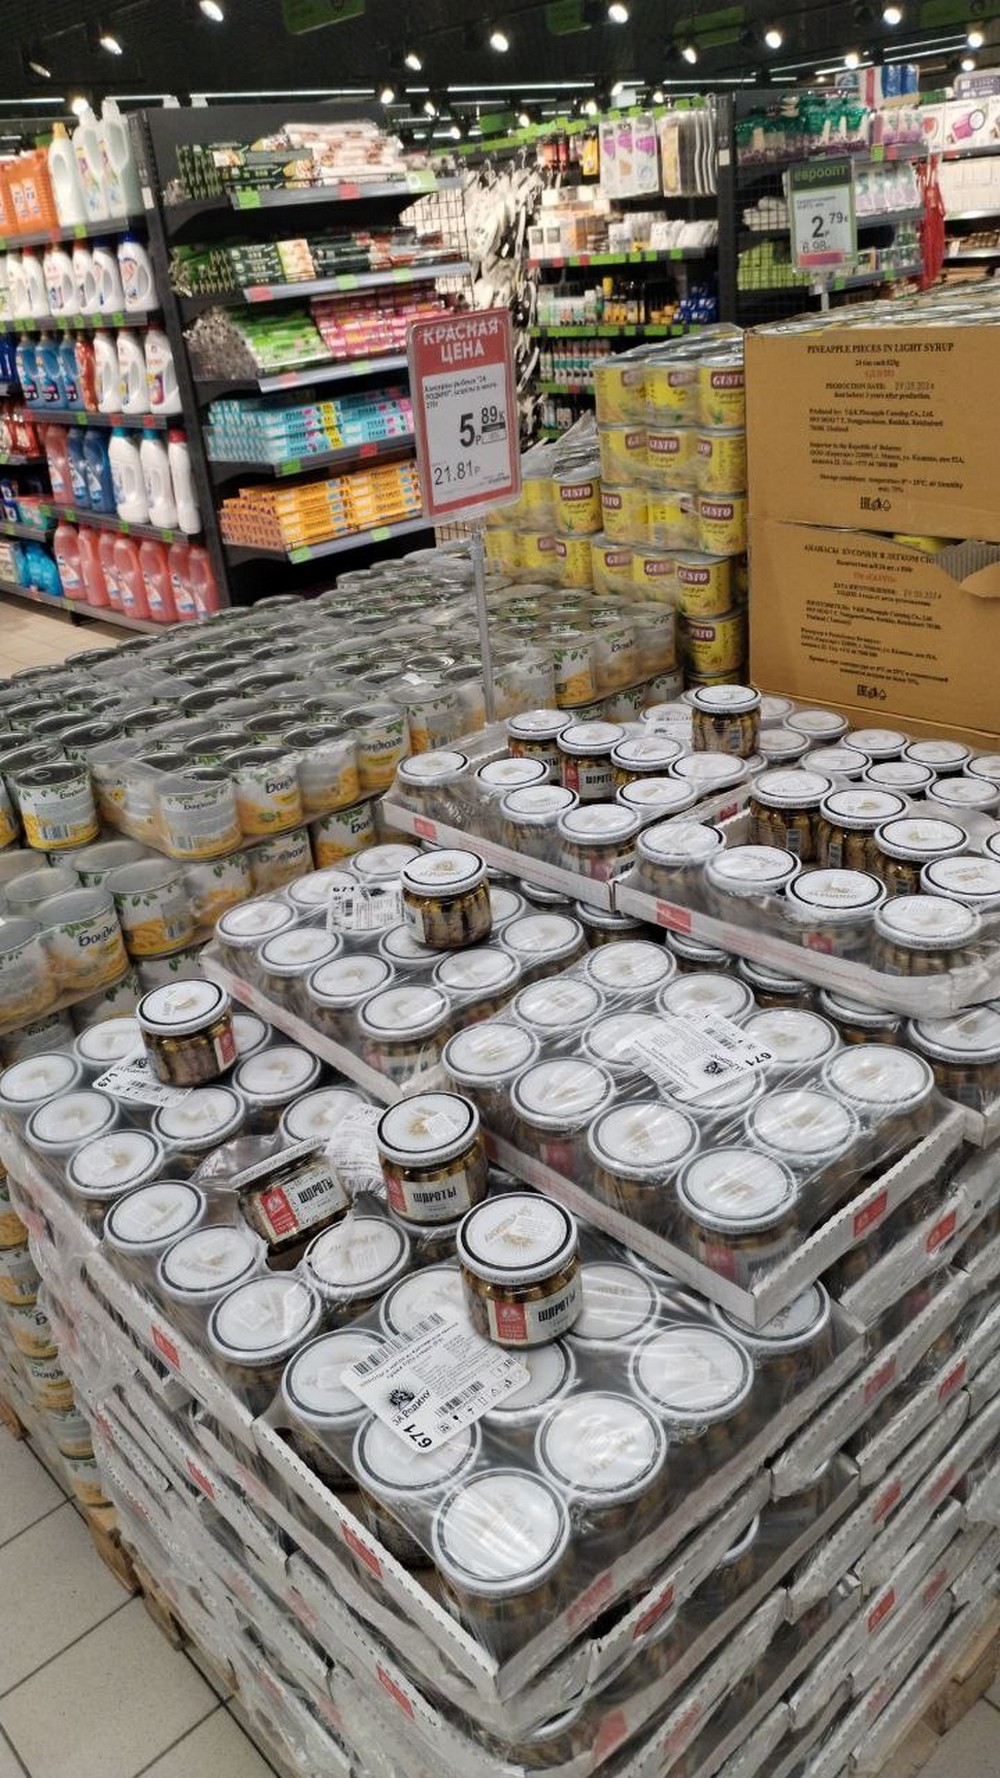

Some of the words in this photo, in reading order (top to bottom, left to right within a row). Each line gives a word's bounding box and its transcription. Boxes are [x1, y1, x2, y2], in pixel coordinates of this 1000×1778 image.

[812, 216, 825, 239] 2
[829, 212, 844, 224] 79
[423, 317, 498, 346] КРАСНАЯ
[441, 339, 485, 364] ЦЕНА
[807, 345, 852, 354] PINEAPPLE
[853, 344, 882, 353] PIECES
[883, 344, 893, 352] IN
[894, 343, 921, 352] LIGHT
[923, 342, 954, 352] SYRUP
[826, 382, 866, 390] PRODUCTION
[460, 413, 475, 448] 5
[481, 405, 498, 424] 89
[434, 460, 473, 486] 21.81
[561, 487, 591, 498] GUSTO
[702, 505, 732, 518] GUSTO
[804, 544, 839, 554] АНАНАСЫ
[678, 570, 708, 582] GUSTO
[746, 1052, 772, 1067] 671
[97, 1073, 119, 1088] 671
[298, 1177, 334, 1204] ШПРОТЫ
[412, 1186, 457, 1204] ШПРОТЫ
[538, 1290, 576, 1322] ШПРОТЫ
[403, 1423, 433, 1449] 671
